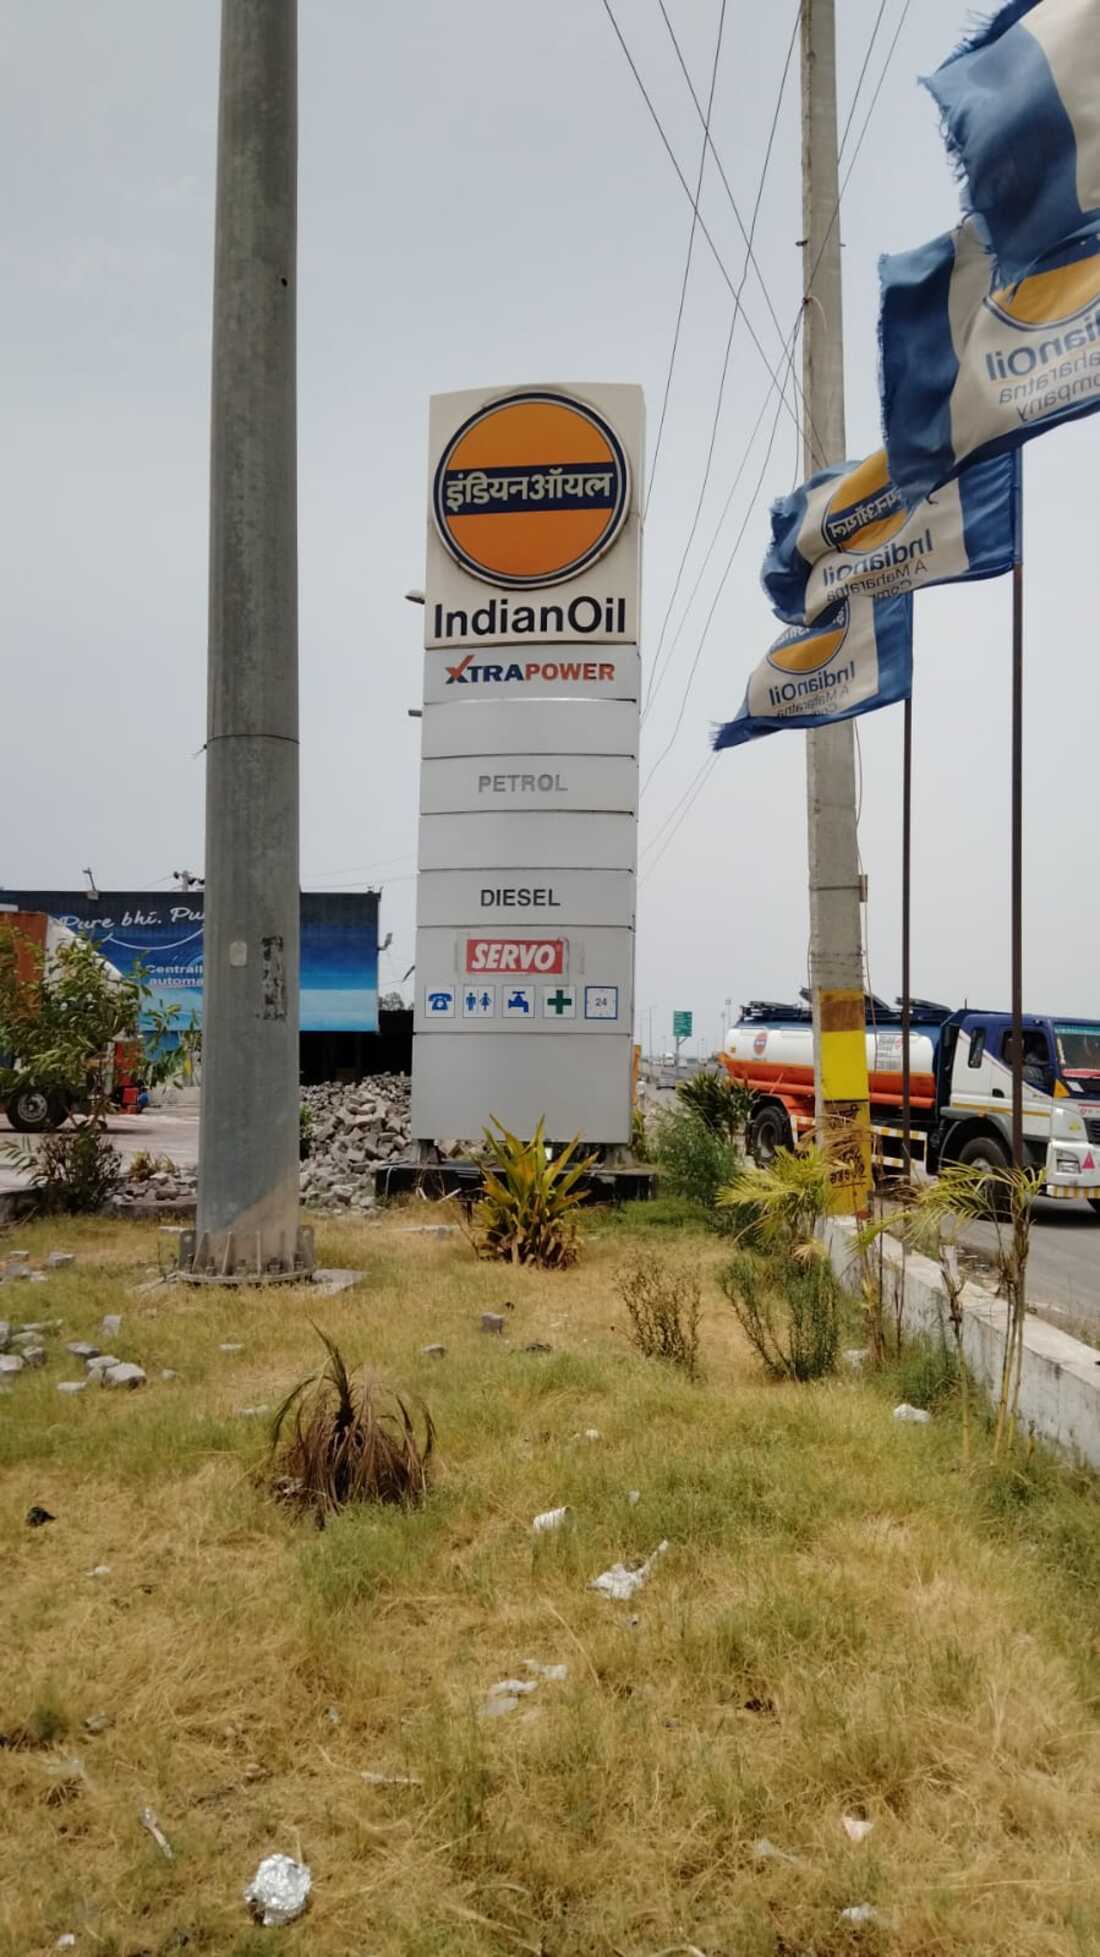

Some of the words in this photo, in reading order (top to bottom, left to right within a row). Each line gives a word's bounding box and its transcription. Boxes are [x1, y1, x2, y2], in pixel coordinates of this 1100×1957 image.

[446, 468, 613, 512] इंडियनऑयल
[434, 595, 626, 638] IndianOil
[445, 655, 615, 684] XTRAPOWER
[478, 774, 569, 793] PETROL
[480, 889, 561, 907] DIESEL
[57, 914, 115, 929] Pure
[471, 943, 556, 971] SERVO
